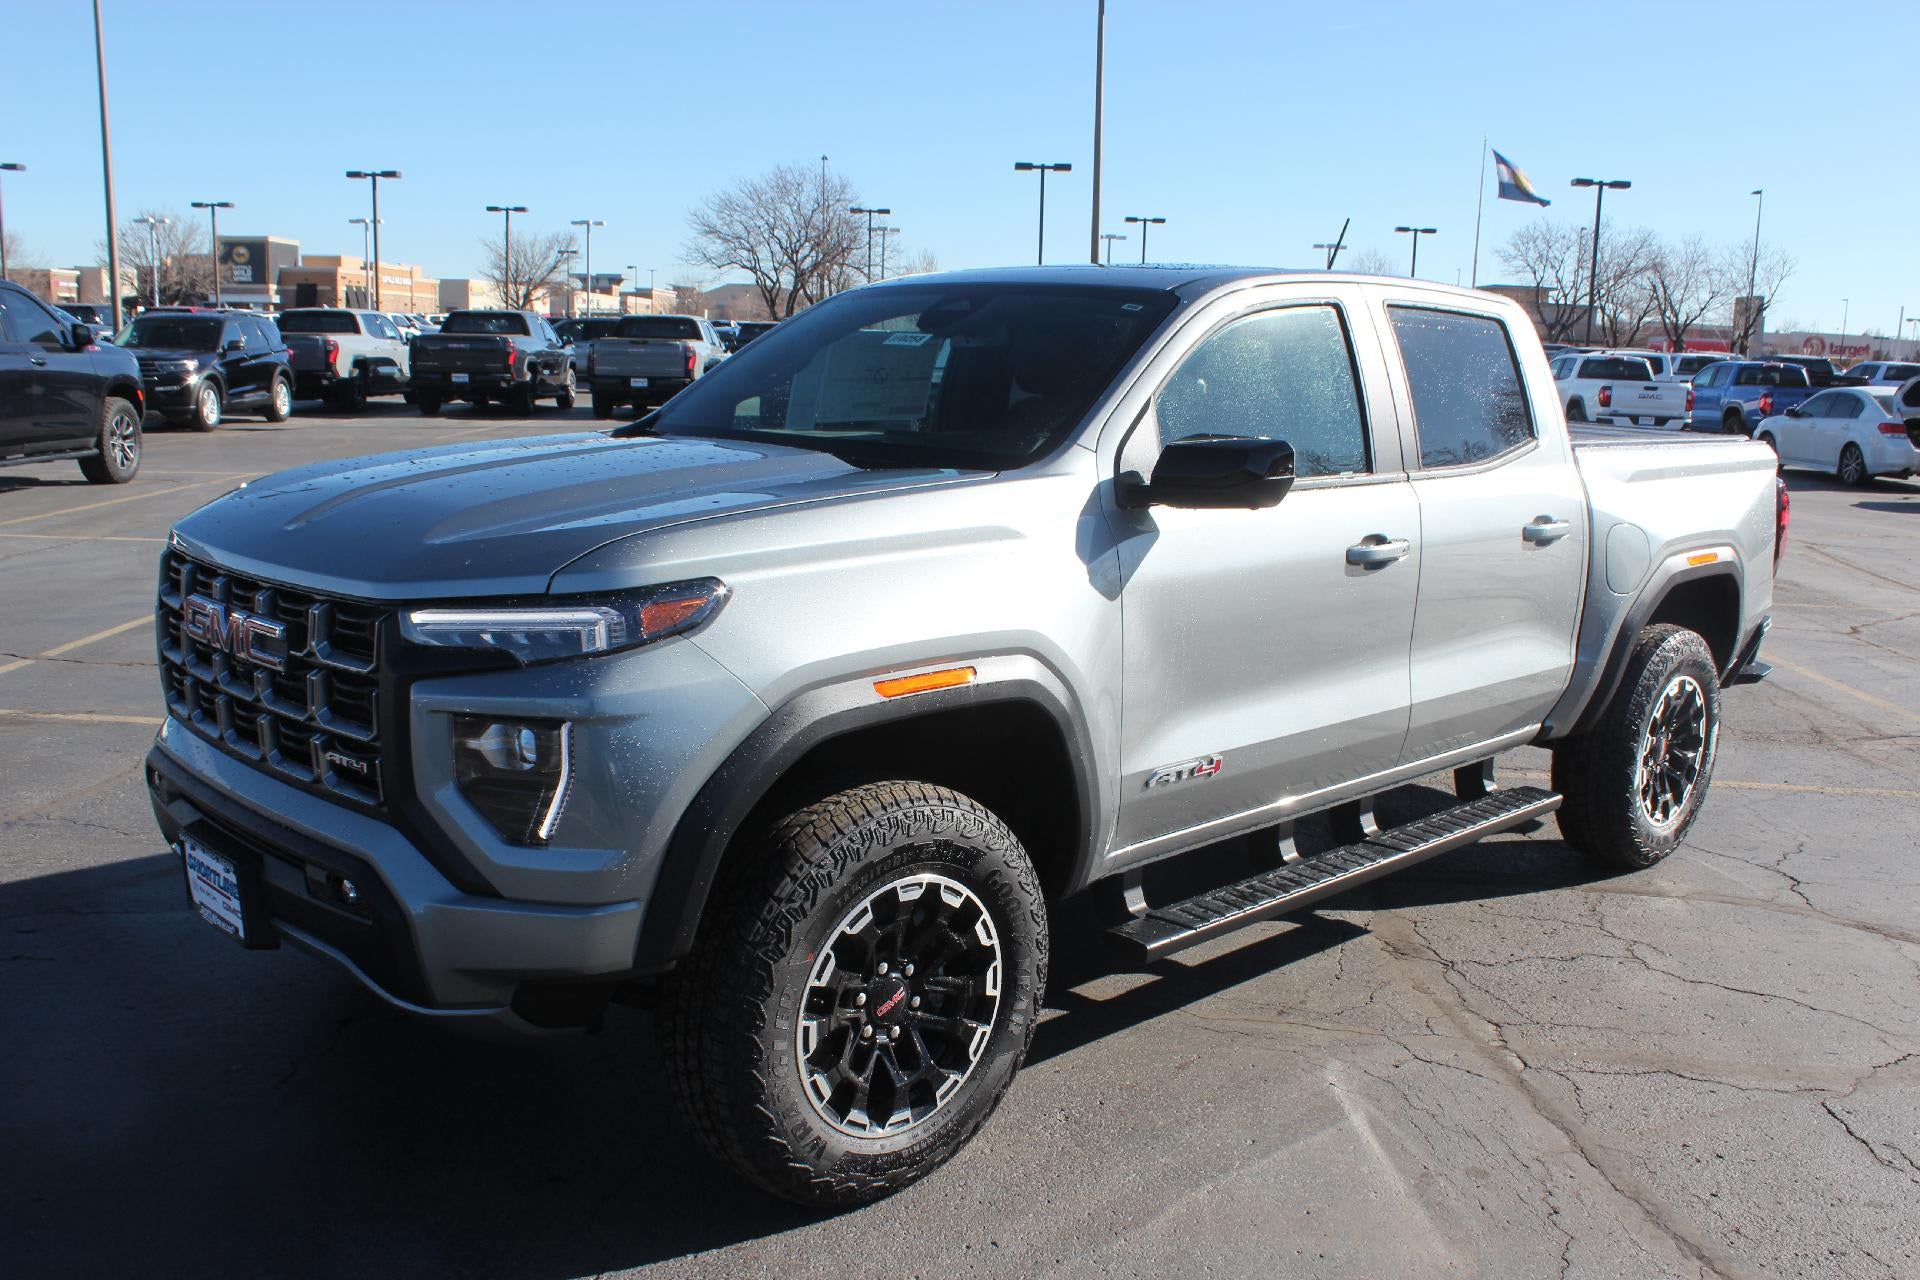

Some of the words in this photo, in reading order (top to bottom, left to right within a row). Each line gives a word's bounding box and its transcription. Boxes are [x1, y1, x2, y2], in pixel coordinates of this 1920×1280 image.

[1829, 342, 1870, 357] target
[185, 593, 285, 671] GMC
[325, 751, 367, 775] AT4
[1143, 752, 1223, 790] AT4
[187, 852, 240, 901] SHORTLINE
[876, 986, 905, 1017] GMC
